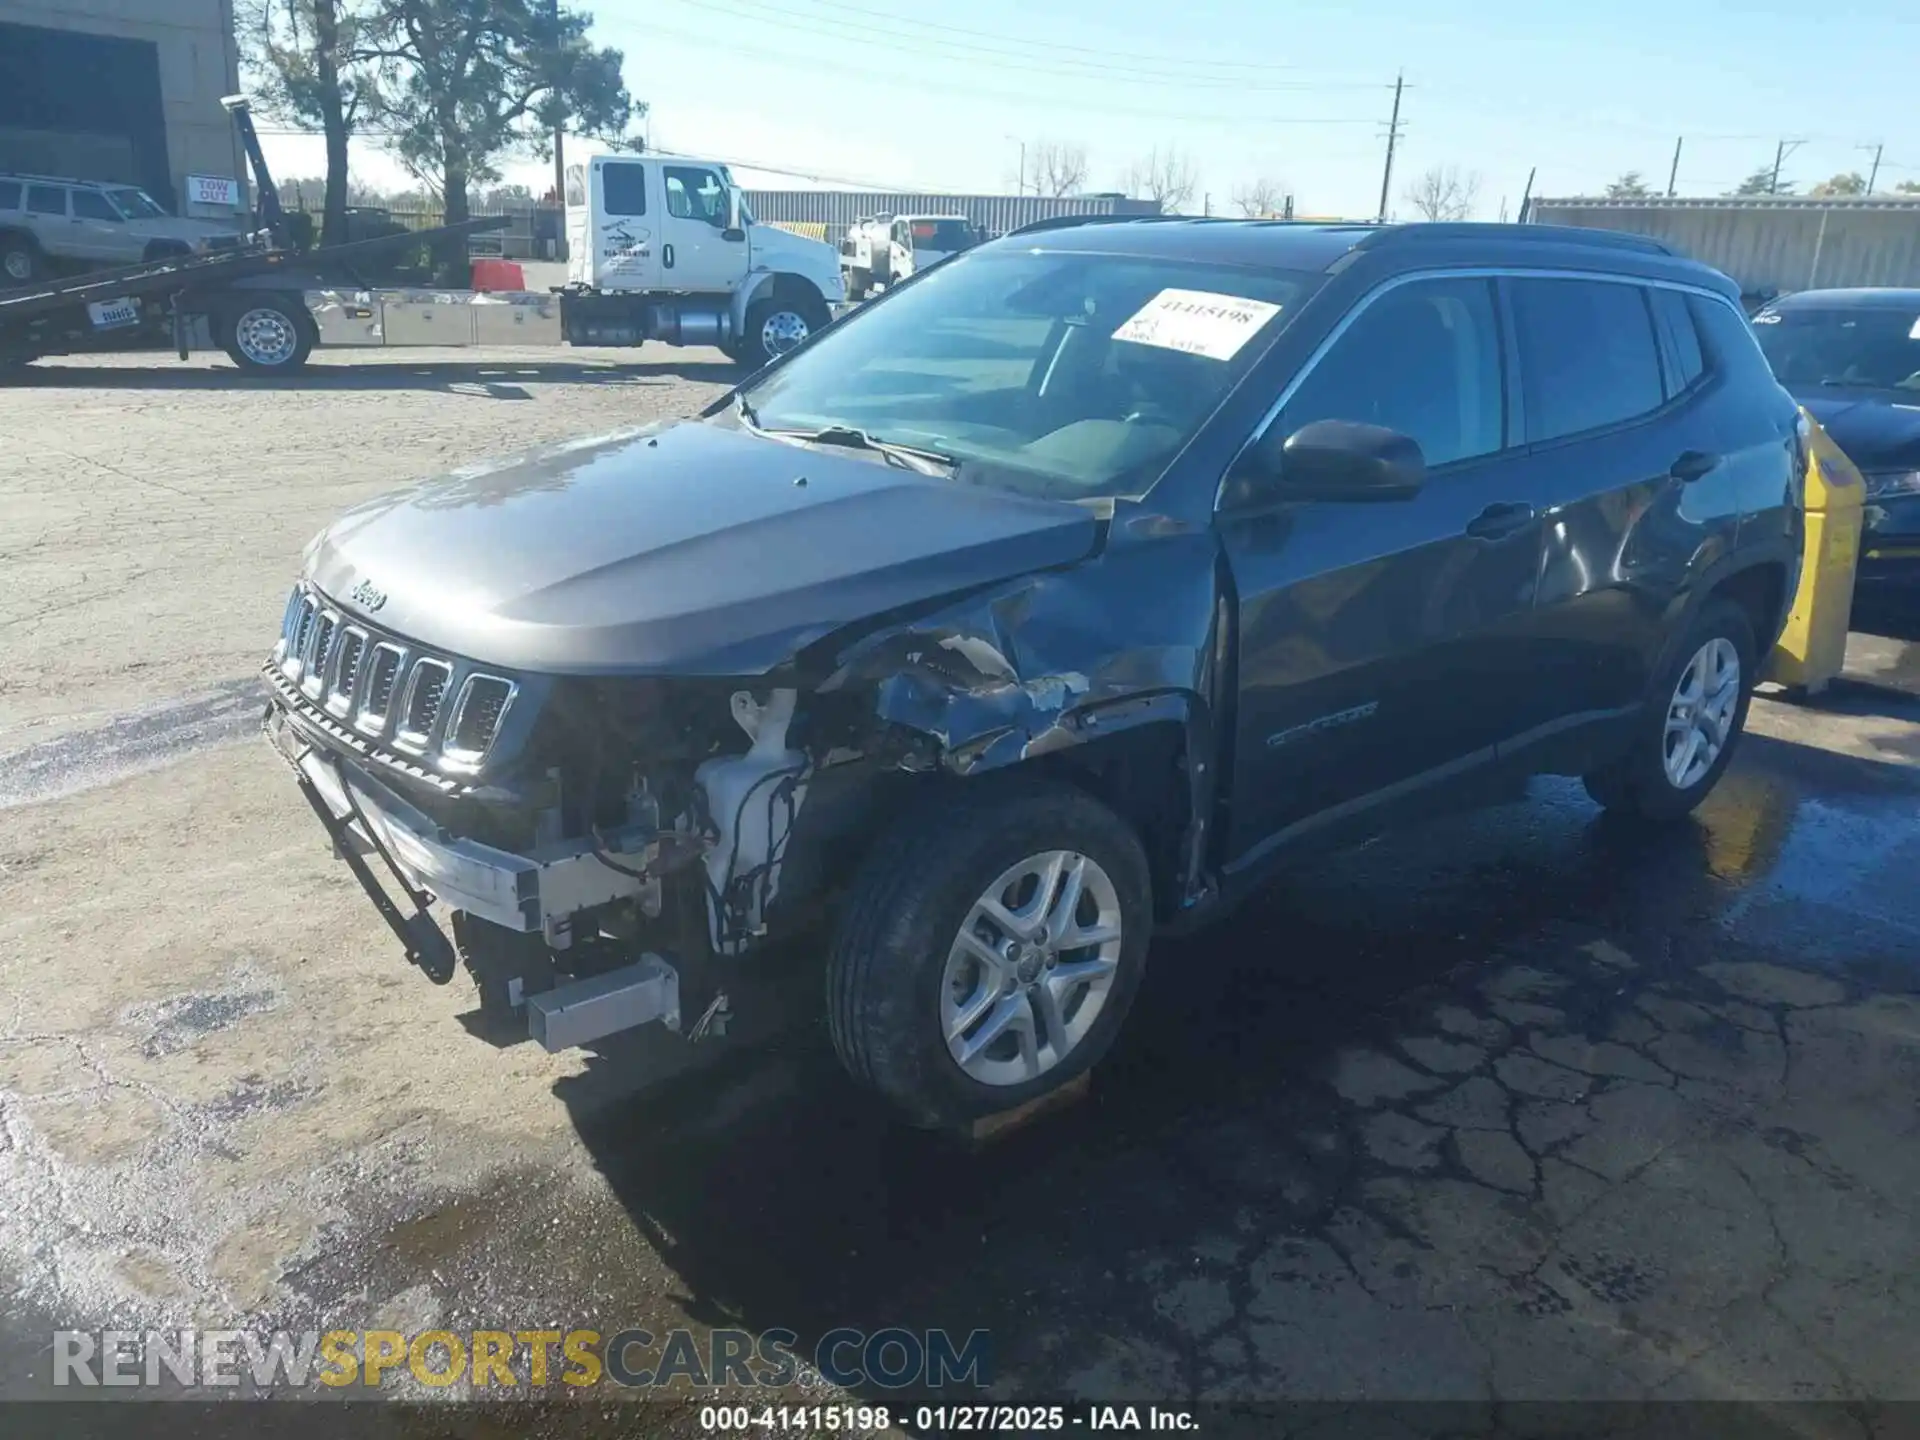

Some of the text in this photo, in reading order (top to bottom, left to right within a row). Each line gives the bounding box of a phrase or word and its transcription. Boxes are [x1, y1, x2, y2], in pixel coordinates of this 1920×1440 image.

[198, 179, 228, 191] TOW
[200, 190, 228, 201] OUT
[352, 578, 388, 613] Jeep
